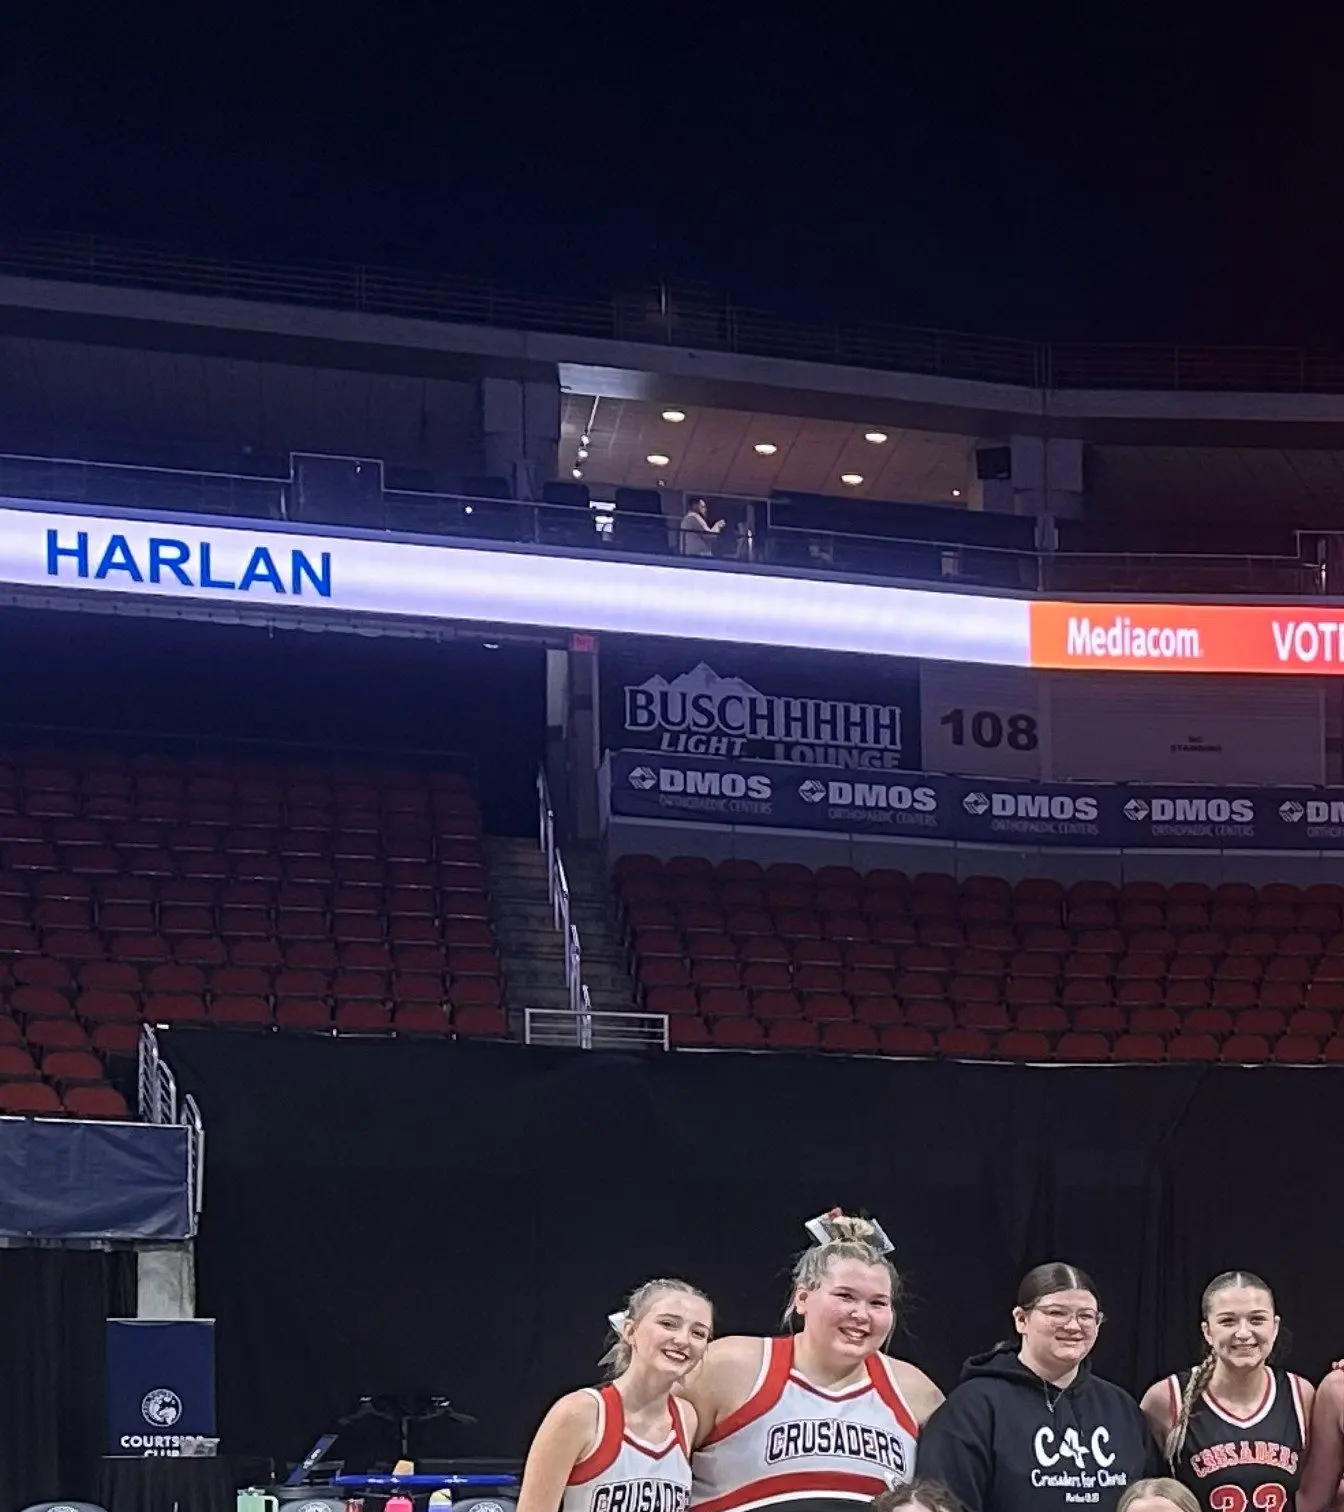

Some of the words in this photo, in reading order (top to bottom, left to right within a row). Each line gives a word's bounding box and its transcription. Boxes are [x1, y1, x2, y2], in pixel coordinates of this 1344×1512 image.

[46, 528, 332, 598] HARLAN
[1067, 617, 1201, 659] Mediacom
[660, 733, 748, 757] LIGHT
[940, 708, 1038, 751] 108
[659, 768, 773, 800] DMOS
[828, 781, 937, 812] DMOS
[992, 793, 1099, 821] DMOS
[1151, 798, 1255, 823] DMOS
[768, 1420, 907, 1473] CRUSADERS
[1190, 1440, 1299, 1478] CRUSADERS
